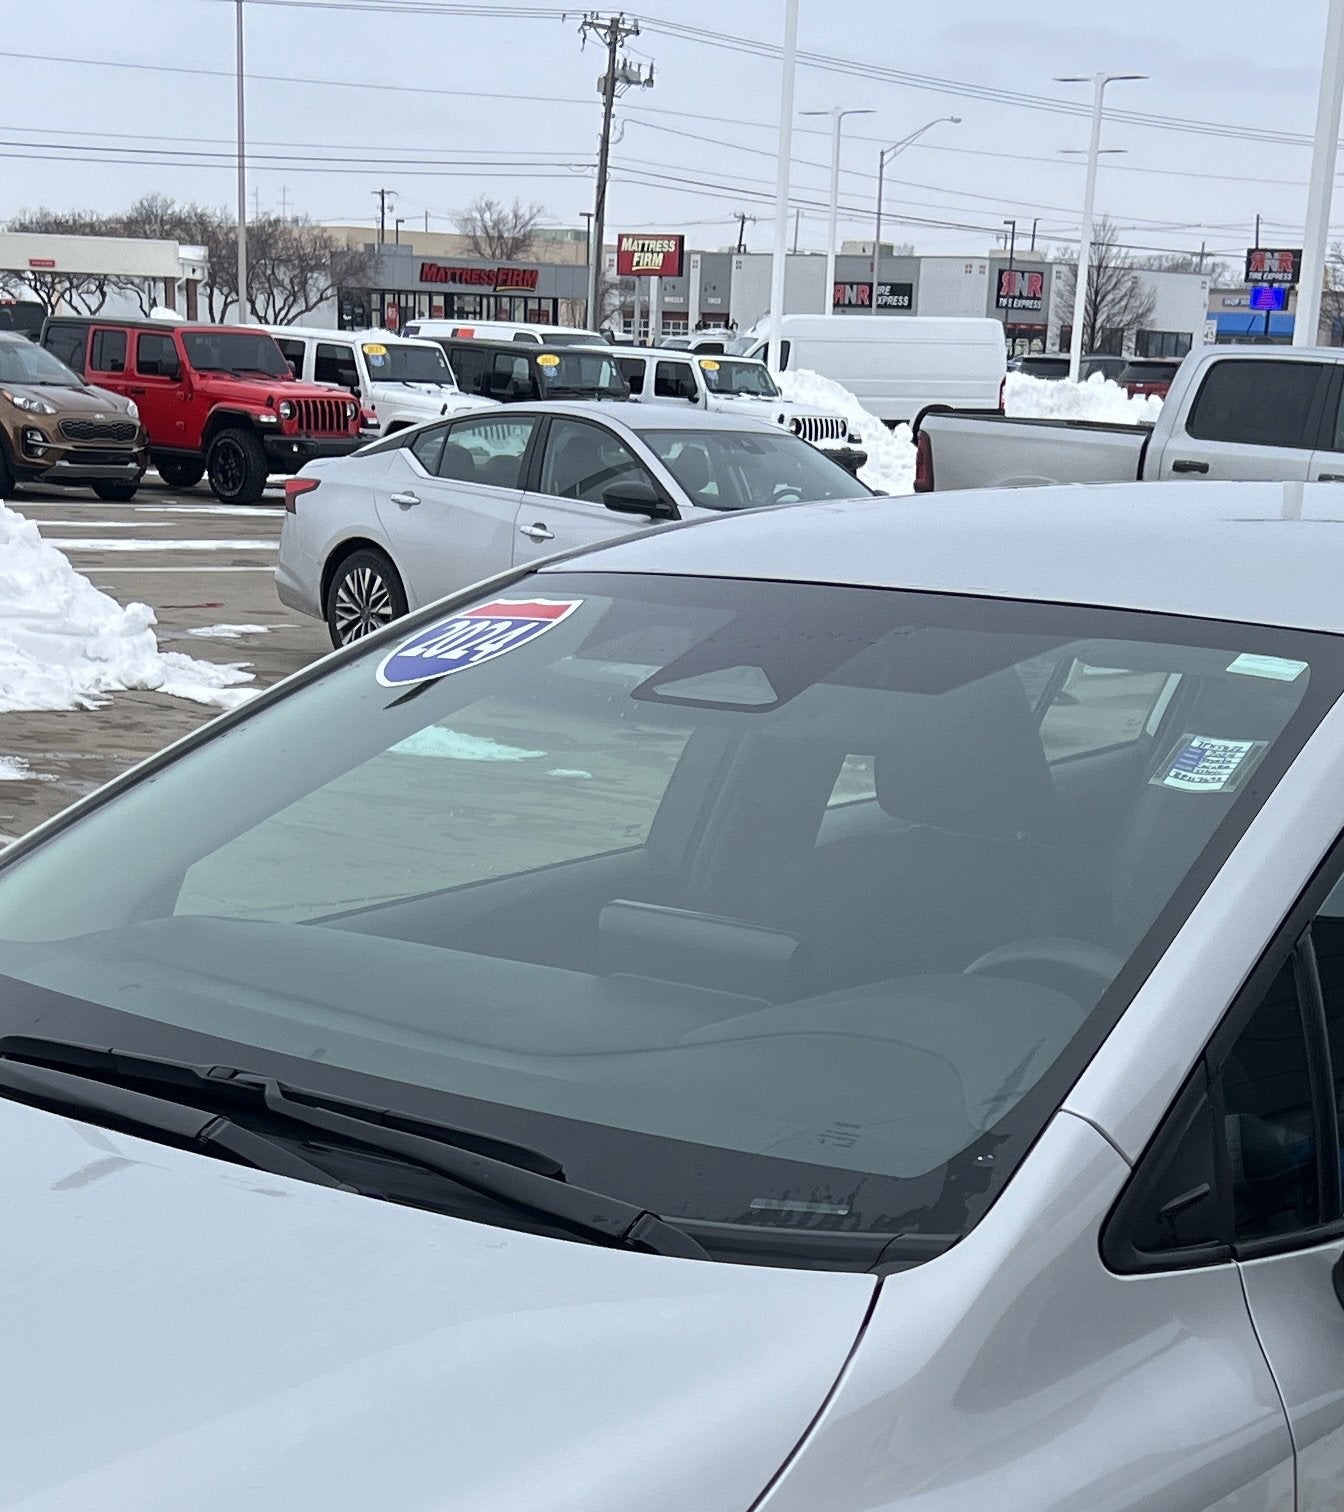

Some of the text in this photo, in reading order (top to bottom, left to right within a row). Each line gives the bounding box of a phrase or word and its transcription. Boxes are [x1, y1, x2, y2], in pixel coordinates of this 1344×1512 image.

[621, 237, 676, 252] MATTRESS
[632, 252, 664, 267] FIRM
[419, 262, 539, 290] MATTRESS FIRM
[876, 285, 892, 296] IRE
[876, 295, 910, 306] XPRESS
[397, 620, 539, 662] 2024
